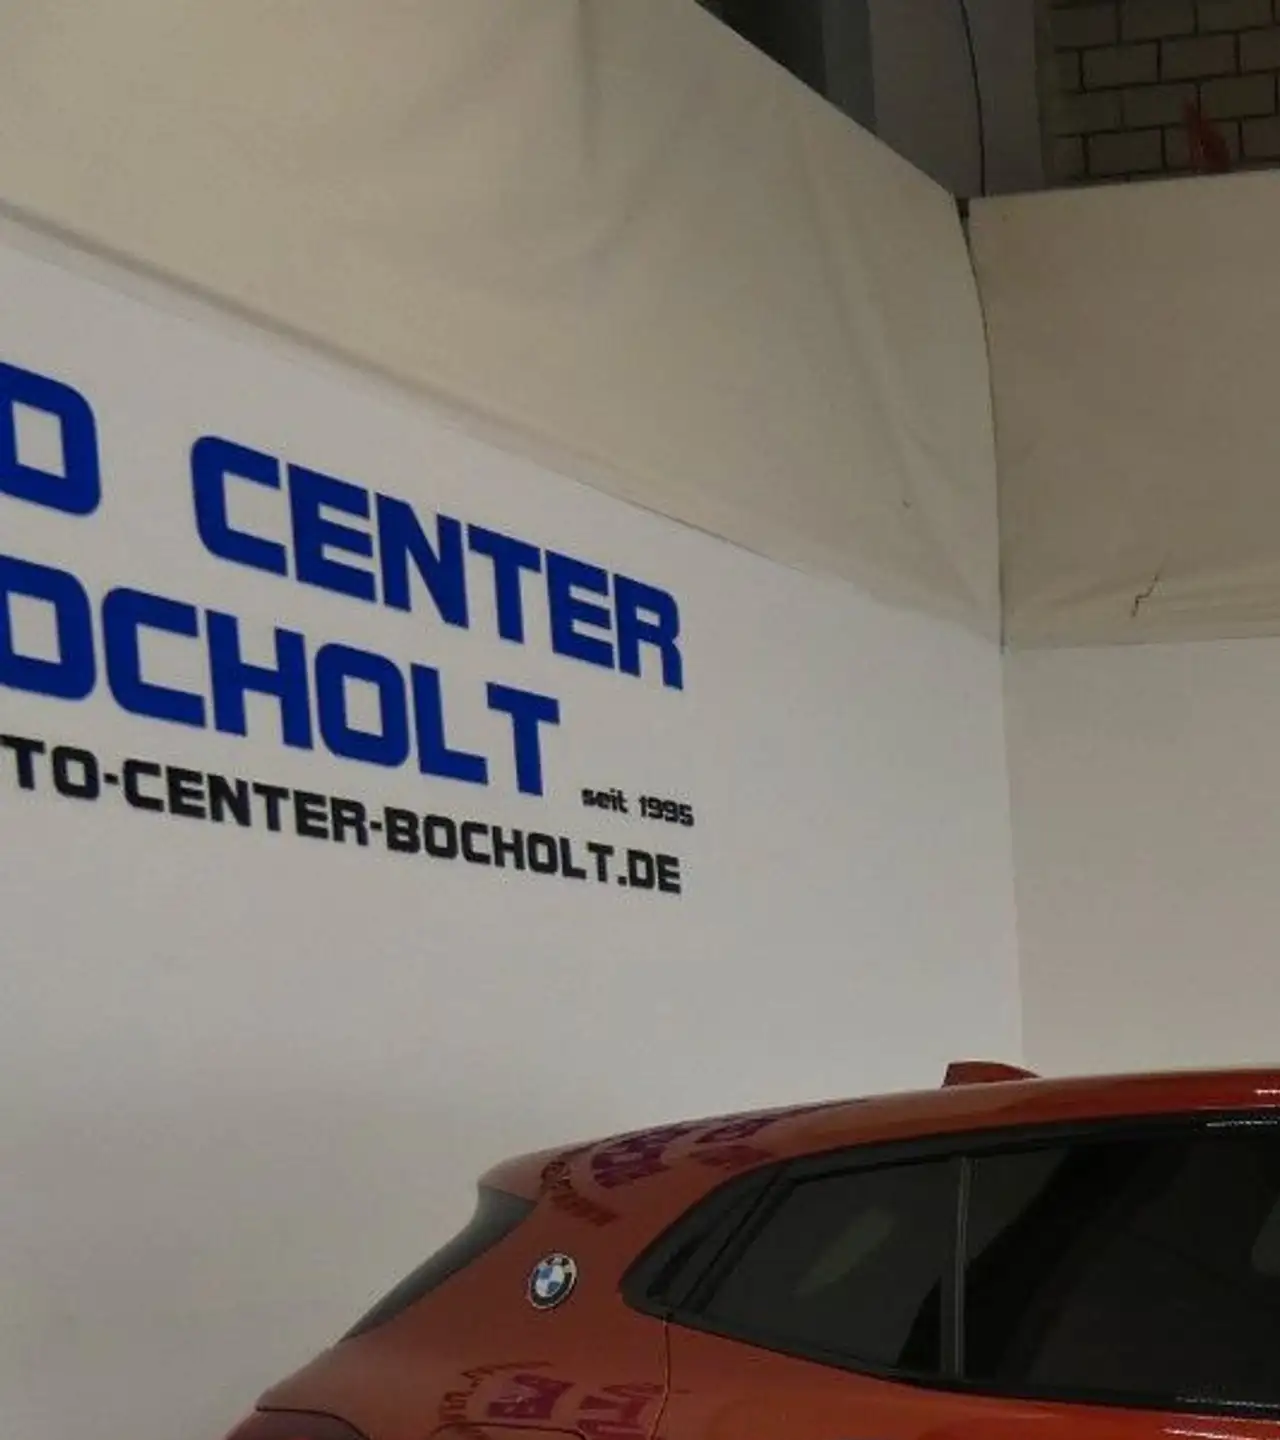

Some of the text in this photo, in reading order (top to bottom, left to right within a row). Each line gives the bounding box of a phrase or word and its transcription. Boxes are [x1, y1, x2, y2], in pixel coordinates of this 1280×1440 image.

[189, 435, 684, 691] CENTER
[0, 733, 681, 895] TO-CENTER-BOCHOLT.DE
[581, 788, 629, 815] seit
[638, 795, 695, 827] 1995
